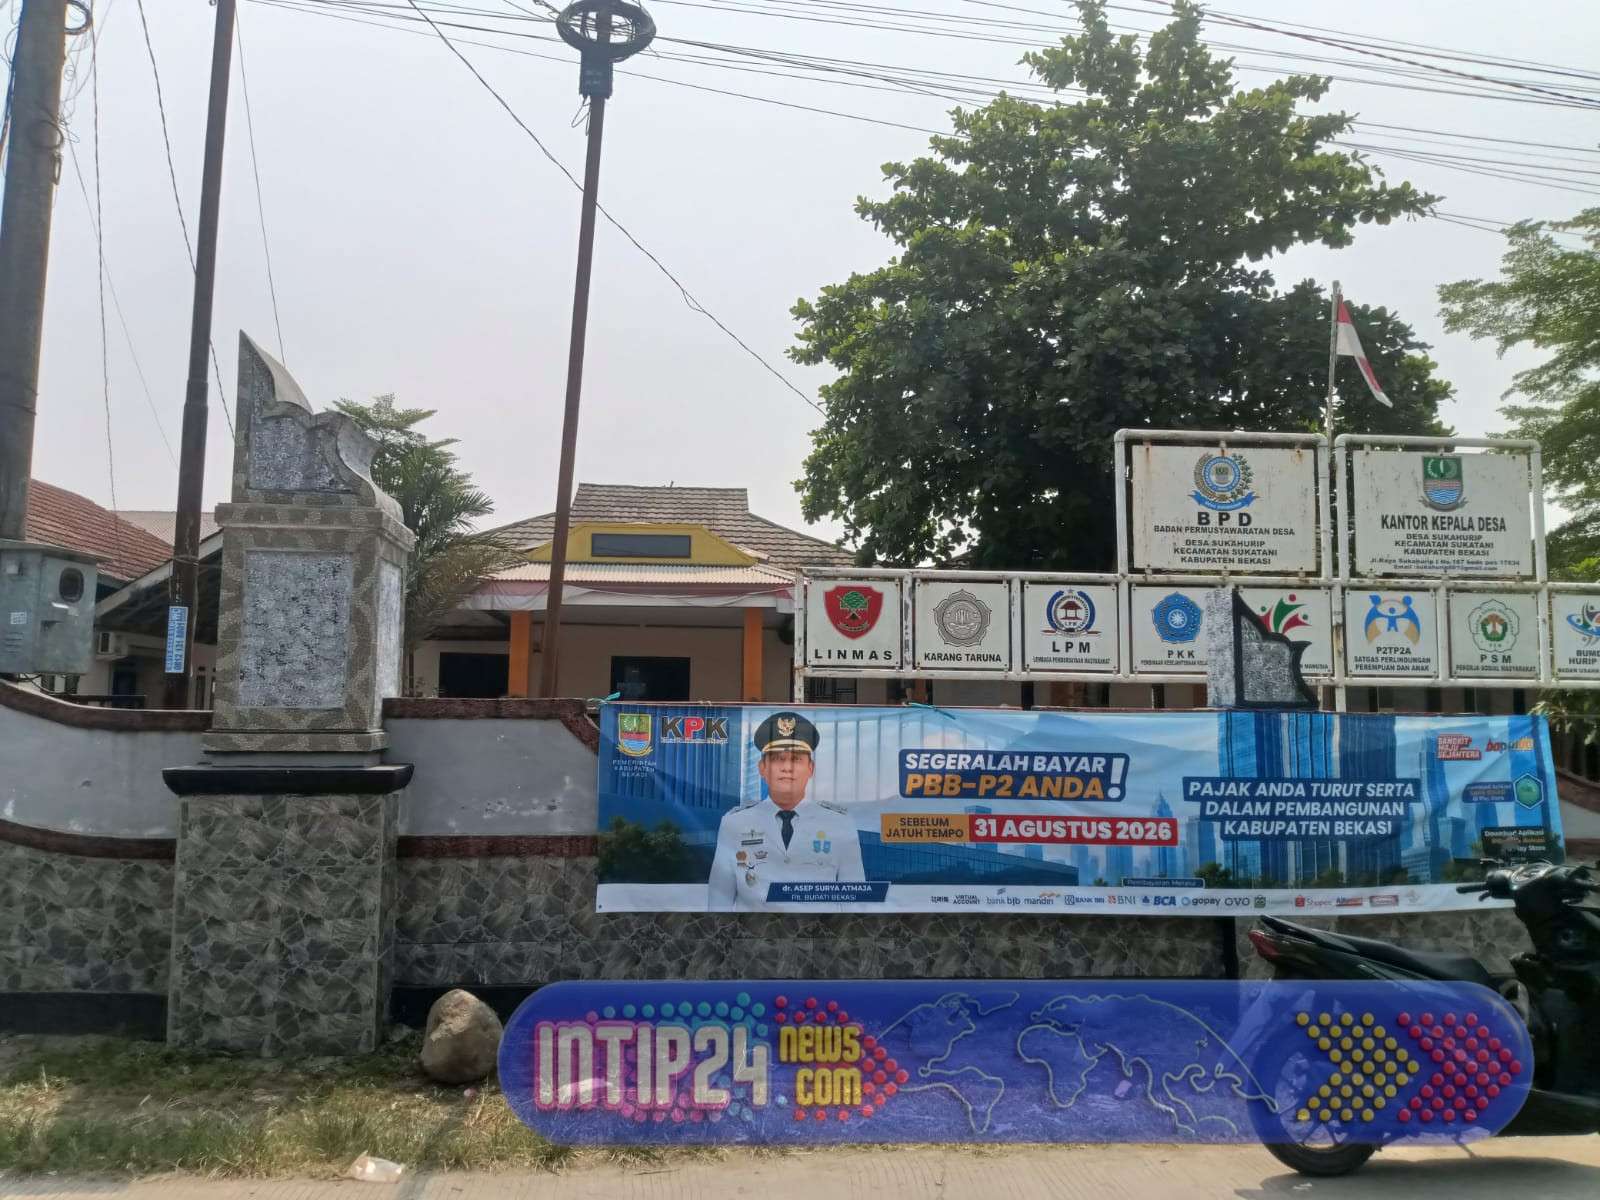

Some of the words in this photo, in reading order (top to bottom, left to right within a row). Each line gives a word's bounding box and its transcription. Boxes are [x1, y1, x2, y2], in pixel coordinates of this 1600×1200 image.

[1381, 514, 1428, 530] KANTOR
[1432, 516, 1475, 531] KEPALA
[1478, 517, 1507, 532] DESA
[1154, 525, 1182, 533] BADAN
[1185, 526, 1270, 535] PERMUSYAWARATAN
[1272, 528, 1295, 536] DESA
[1185, 539, 1209, 547] DESA
[1211, 540, 1266, 548] SUKAHURIP
[1394, 540, 1449, 548] KECAMATAN
[1451, 541, 1494, 549] SUKATANI
[1173, 548, 1229, 556] KECAMATAN
[1232, 549, 1278, 557] SUKATANI
[1403, 548, 1455, 556] KABUPATEN
[1458, 549, 1490, 557] BEKASI
[1180, 556, 1235, 564] KABUPATEN
[1237, 557, 1271, 565] BEKASI
[1052, 641, 1091, 654] LPM
[1376, 646, 1412, 655] P2TP2A
[814, 648, 893, 660] LINMAS
[924, 652, 963, 662] KARANG
[965, 653, 1002, 662] TARUNA
[1167, 650, 1195, 659] PKK
[1480, 654, 1512, 663] PSM
[1381, 656, 1431, 664] PERLINDUNGAN
[1355, 663, 1395, 671] PEREMPUAN
[661, 715, 729, 739] KPK
[905, 752, 1029, 772] SEGERALAH
[1033, 755, 1105, 774] BAYAR
[905, 773, 1013, 798] PBB-P2
[1018, 775, 1105, 799] ANDA
[1189, 781, 1252, 797] PAJAK
[1255, 782, 1306, 797] ANDA
[1311, 782, 1363, 797] TURUT
[1366, 783, 1415, 798] SERTA
[1205, 801, 1271, 816] DALAM
[1274, 801, 1405, 816] PEMBANGUNAN
[900, 817, 949, 827] SEBELUM
[886, 828, 924, 838] JATUH
[925, 829, 964, 838] TEMPO
[975, 818, 997, 838] 31
[1001, 819, 1112, 839] AGUSTUS
[1116, 822, 1172, 841] 2026
[1224, 820, 1330, 836] KABUPATEN
[1334, 821, 1392, 836] BEKASI
[1117, 896, 1136, 905] BNI
[1153, 896, 1176, 906] BCA
[1192, 897, 1220, 906] gopay
[1224, 897, 1250, 906] OVO
